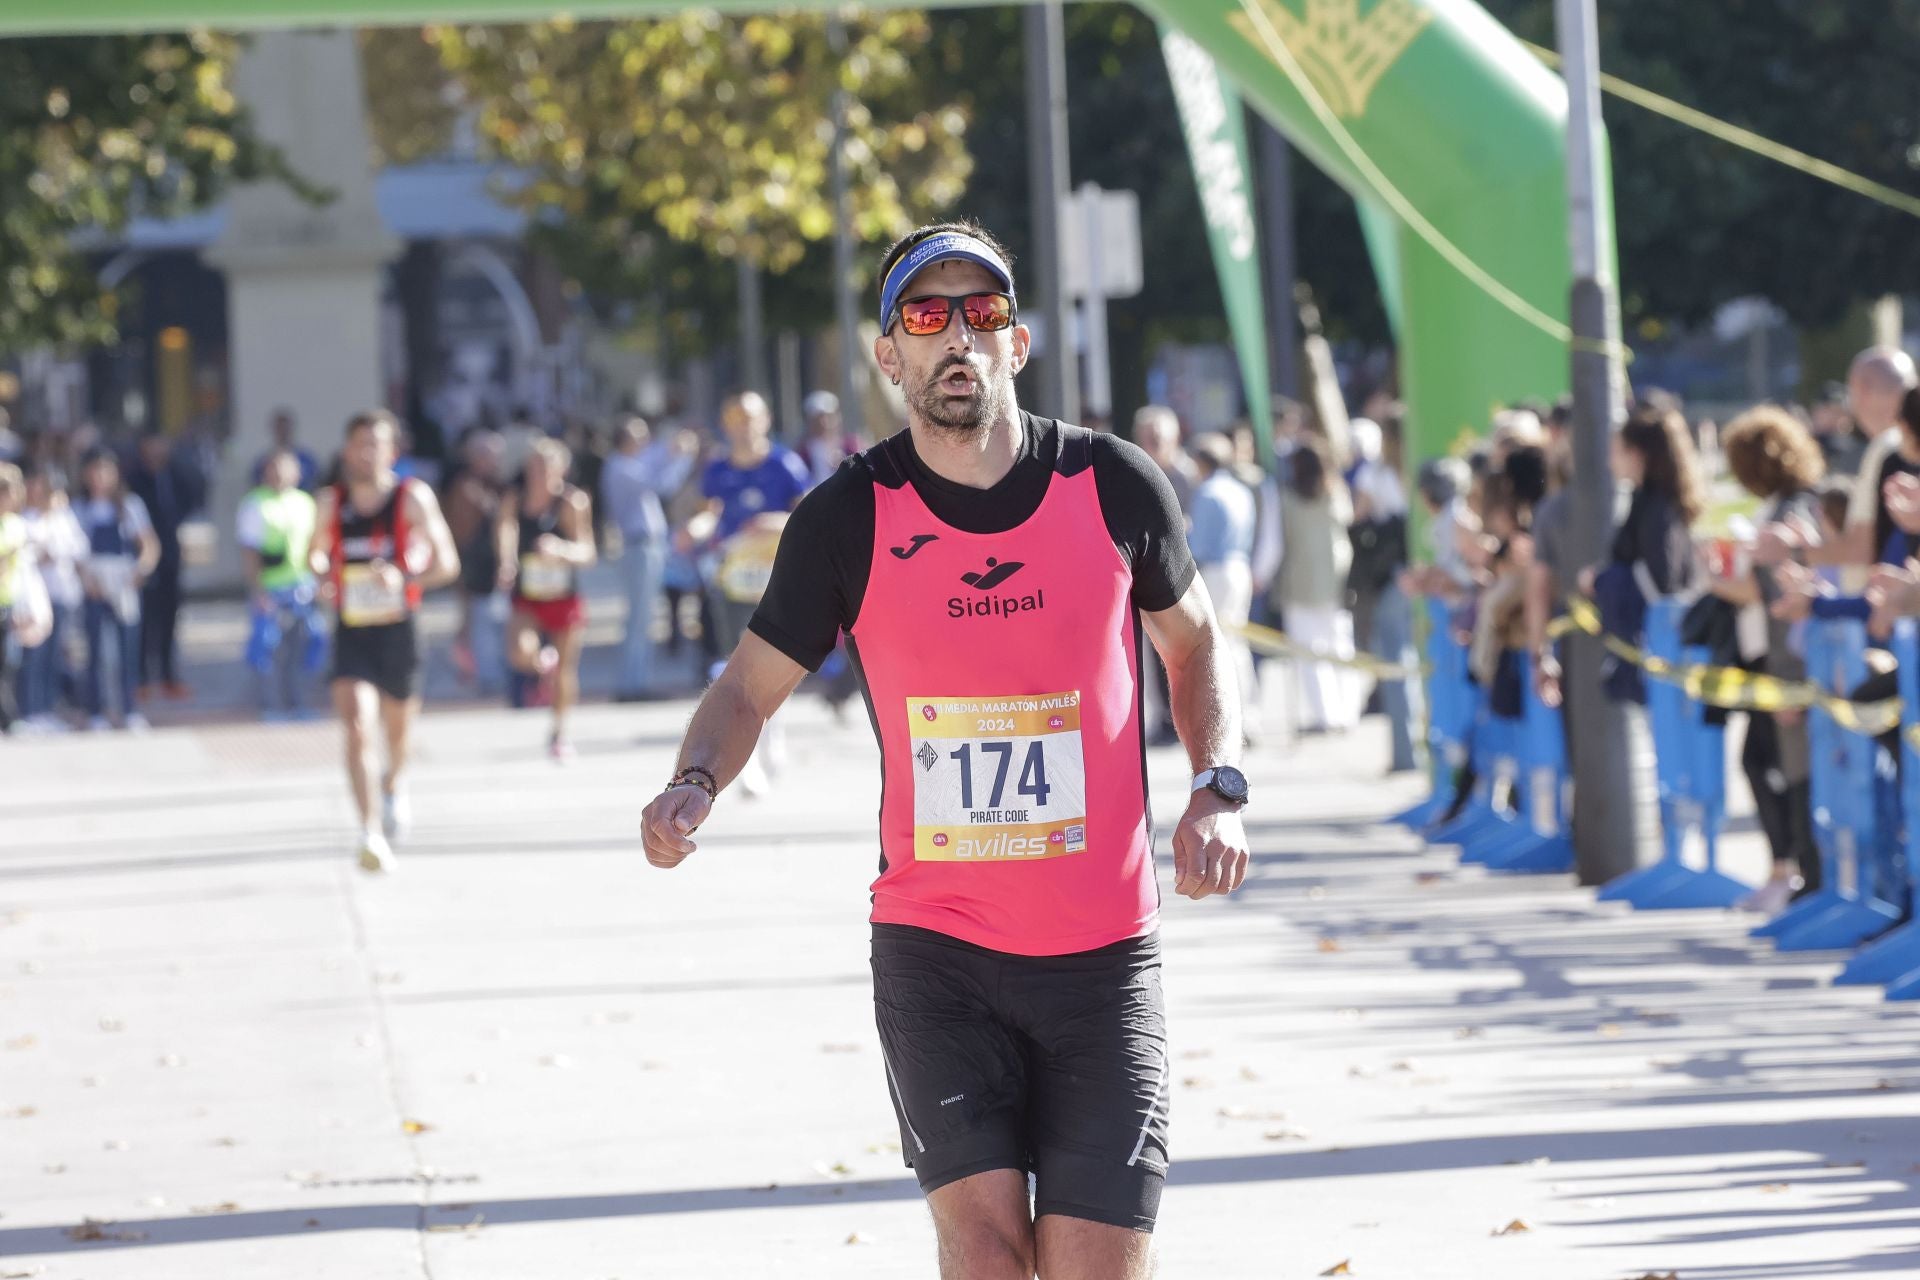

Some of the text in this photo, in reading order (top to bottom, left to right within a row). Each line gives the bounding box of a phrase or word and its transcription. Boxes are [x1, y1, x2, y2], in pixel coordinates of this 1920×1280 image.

[948, 589, 1044, 619] Sidipal
[945, 703, 979, 714] MEDIA
[982, 699, 1038, 713] MARATÓN
[1040, 695, 1077, 711] AVILÉS
[977, 718, 1015, 732] 2024
[950, 740, 1051, 809] 174
[970, 810, 1029, 823] PIRATE CODE
[955, 832, 1048, 857] avilés
[940, 1094, 964, 1106] EVADICT
